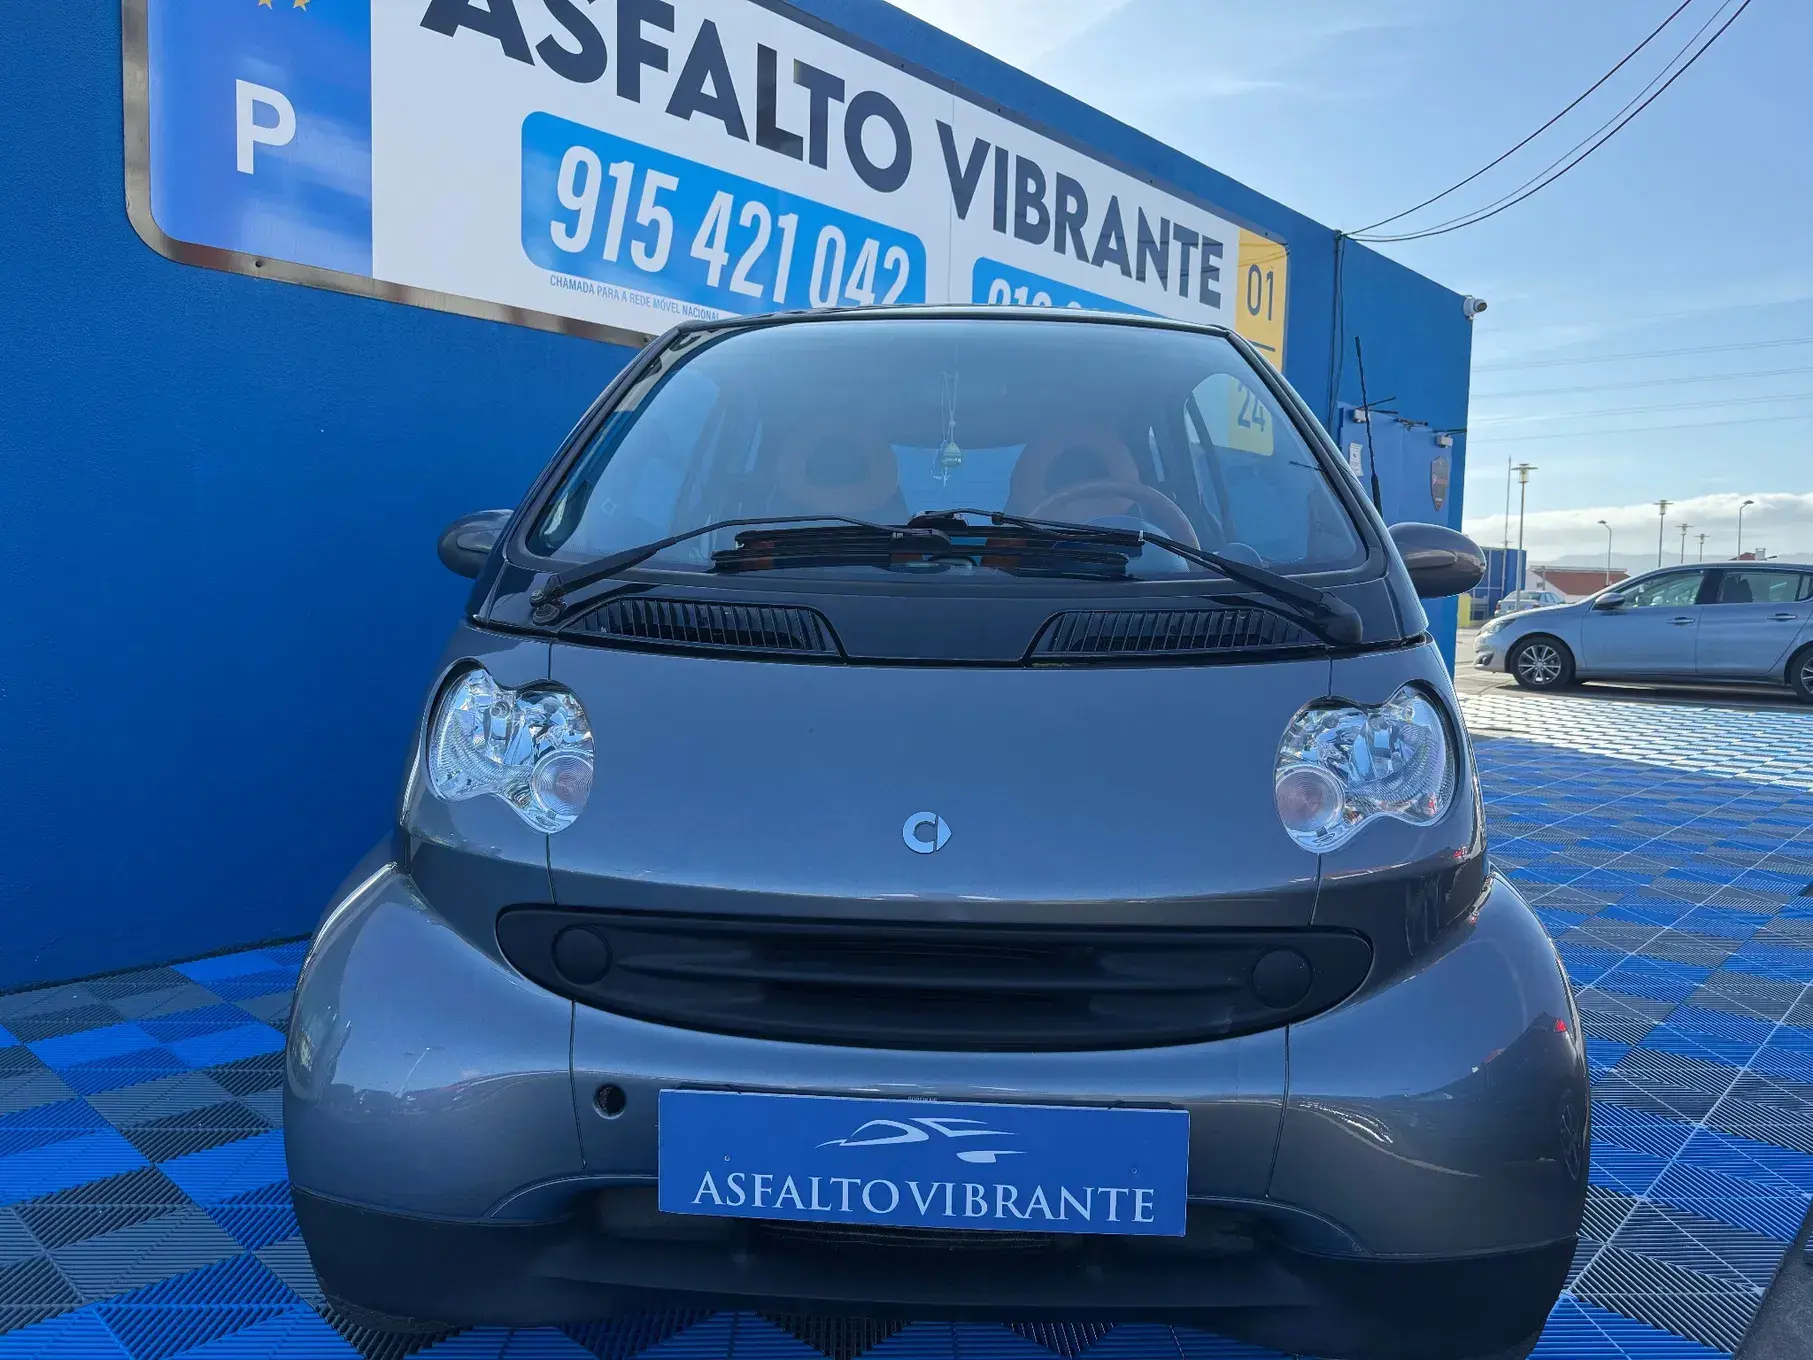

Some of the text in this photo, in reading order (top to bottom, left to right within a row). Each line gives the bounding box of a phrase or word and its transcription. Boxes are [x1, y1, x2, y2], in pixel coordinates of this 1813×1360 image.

[236, 79, 296, 174] P
[551, 146, 910, 309] 915 421 042
[936, 120, 1223, 309] VIBRANTE
[550, 274, 595, 295] CHAMADA
[597, 285, 620, 301] PARA
[621, 291, 628, 302] A
[629, 293, 651, 308] REDE
[653, 297, 680, 315] MÓVEL
[1247, 266, 1274, 321] 01
[1238, 381, 1266, 432] 24
